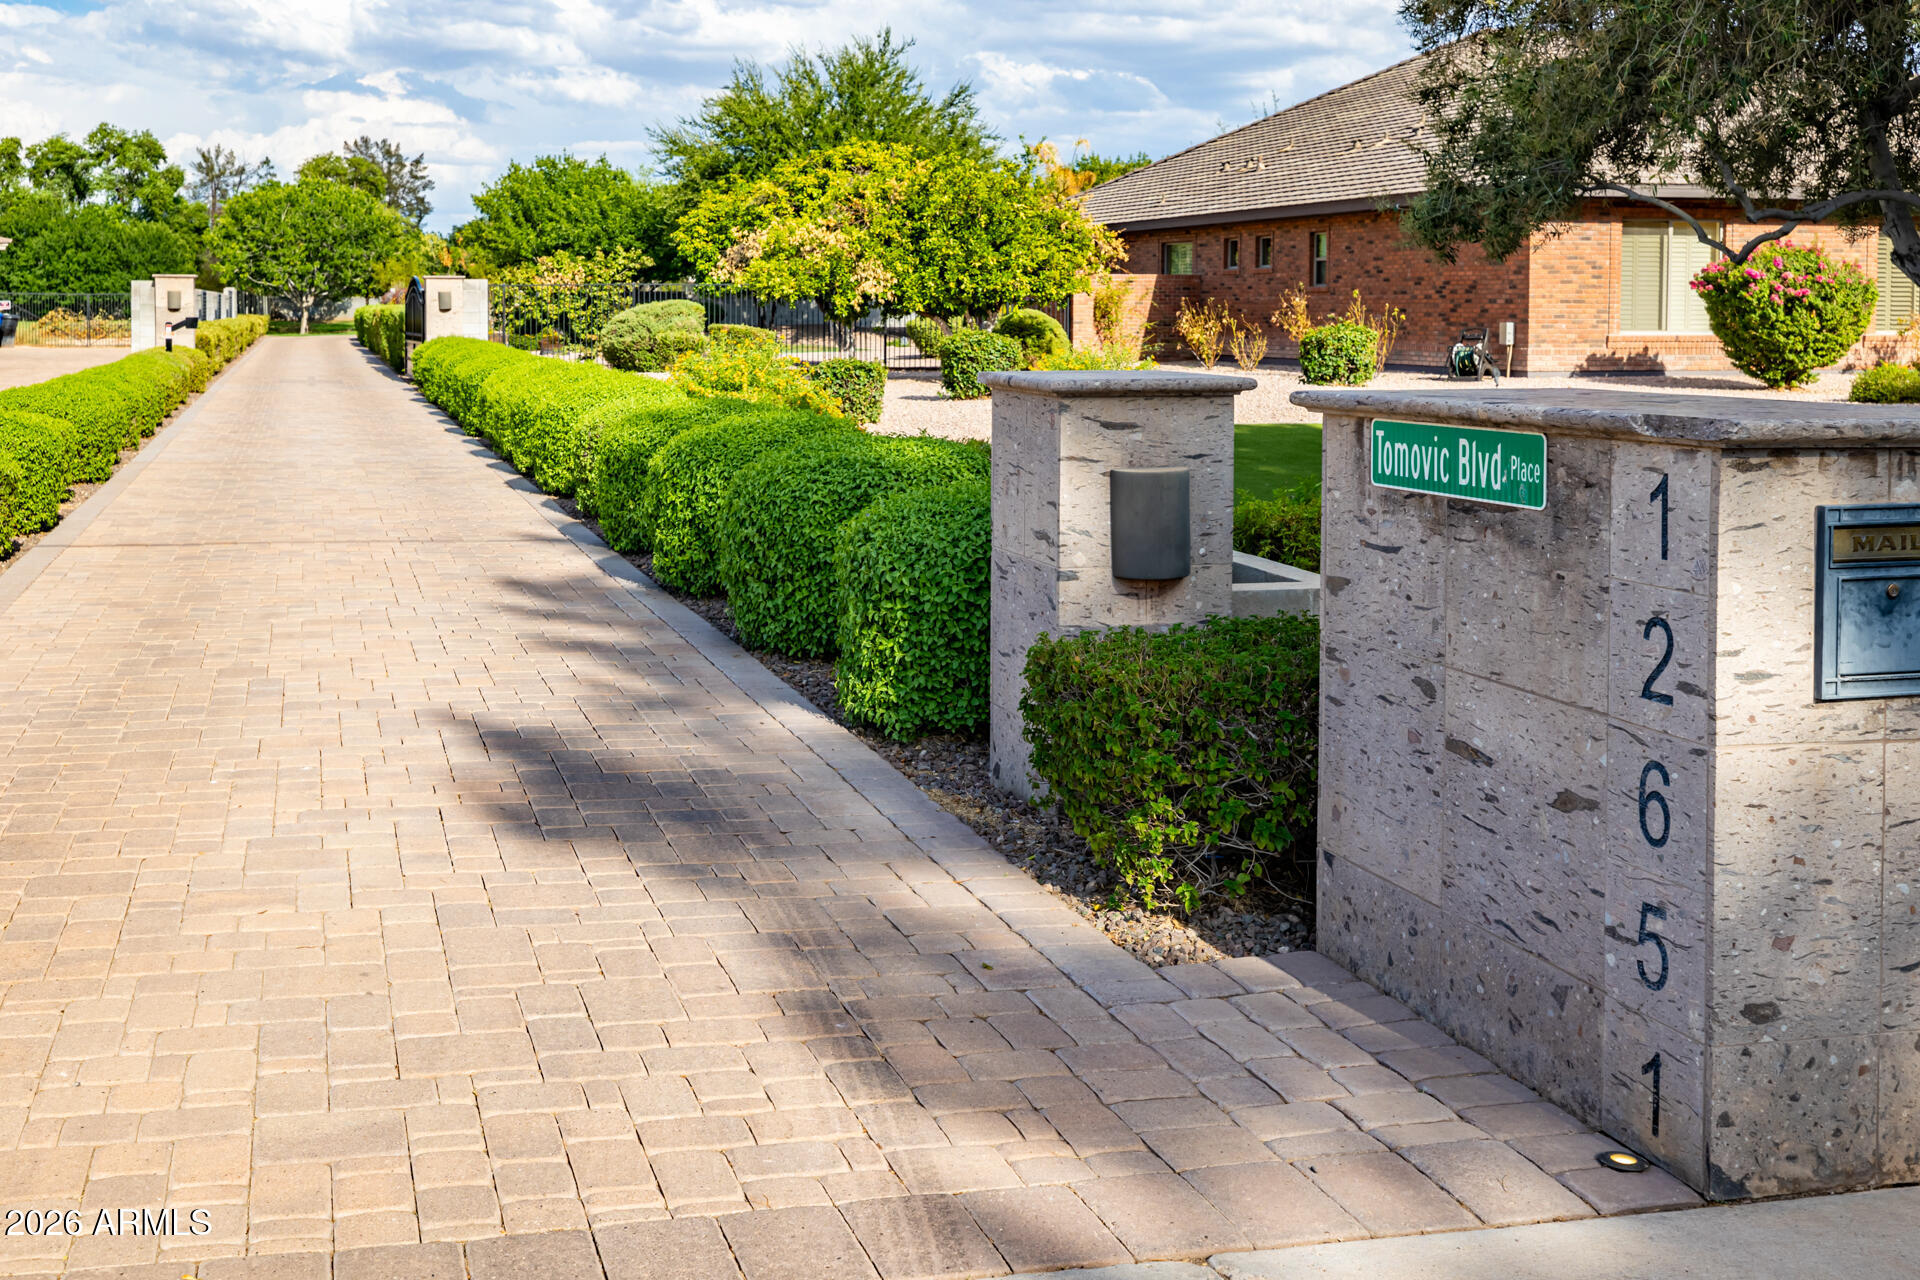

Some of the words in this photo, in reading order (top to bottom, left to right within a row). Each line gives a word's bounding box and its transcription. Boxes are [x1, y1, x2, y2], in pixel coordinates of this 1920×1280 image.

[1375, 430, 1450, 483] Tomovic
[1511, 455, 1540, 484] Place
[1852, 534, 1920, 553] MAIL
